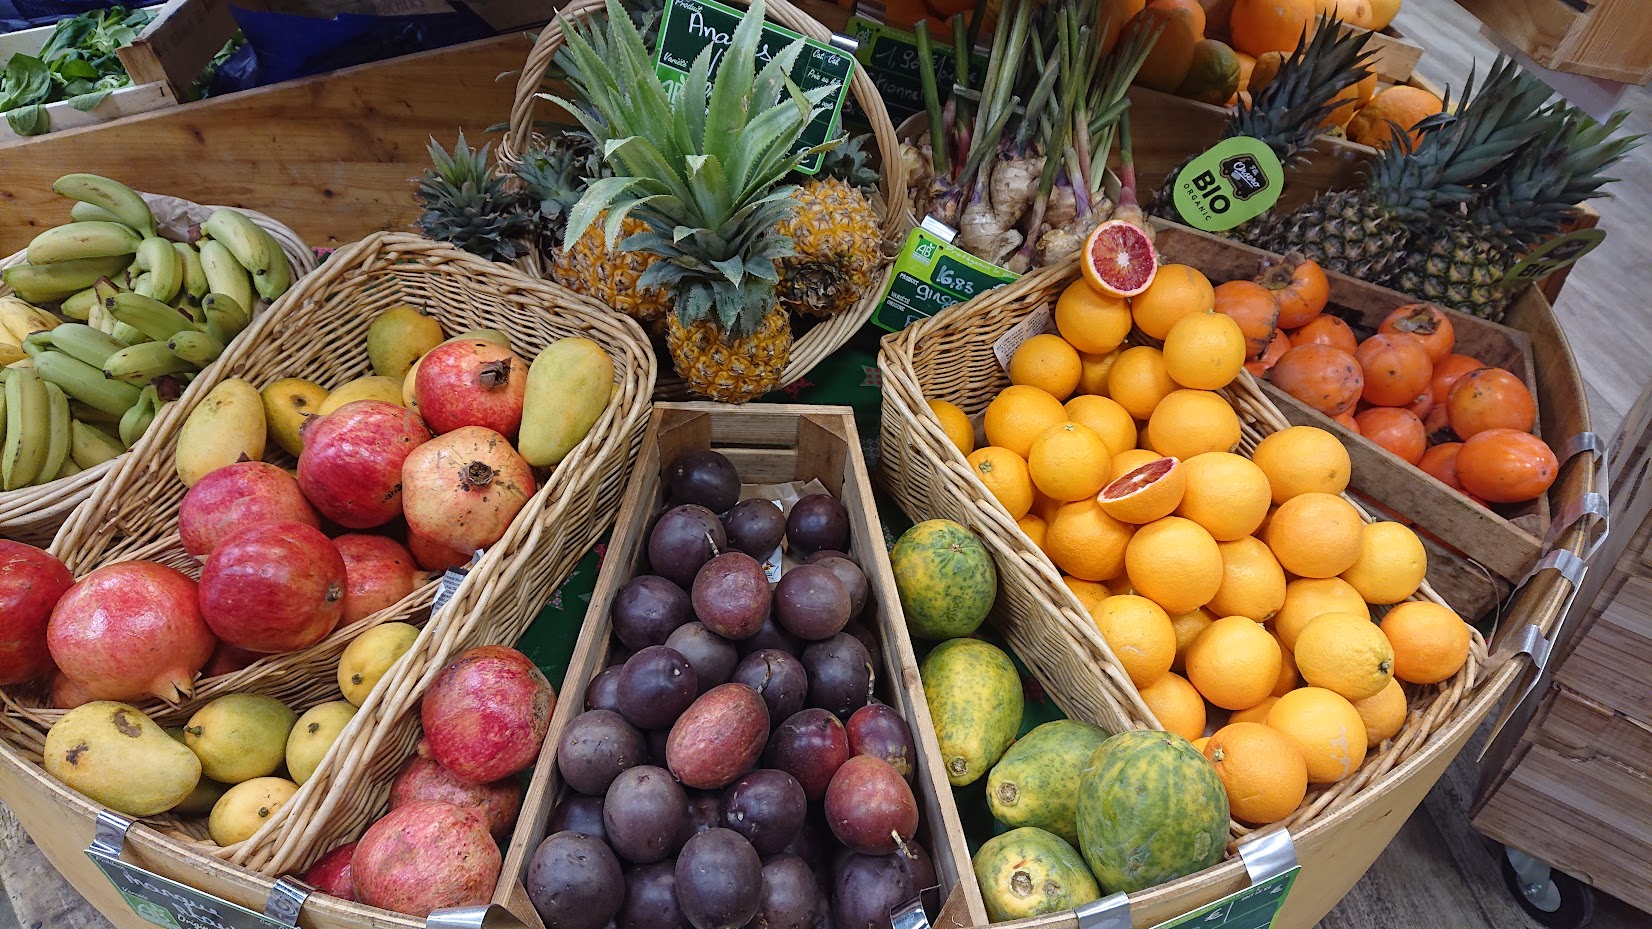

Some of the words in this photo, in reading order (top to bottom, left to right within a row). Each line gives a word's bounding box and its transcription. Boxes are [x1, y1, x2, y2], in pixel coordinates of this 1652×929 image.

[1183, 183, 1212, 221] ORGANIC
[1192, 169, 1231, 214] BIO
[899, 272, 919, 287] PRODUIT
[935, 265, 974, 294] 16,83
